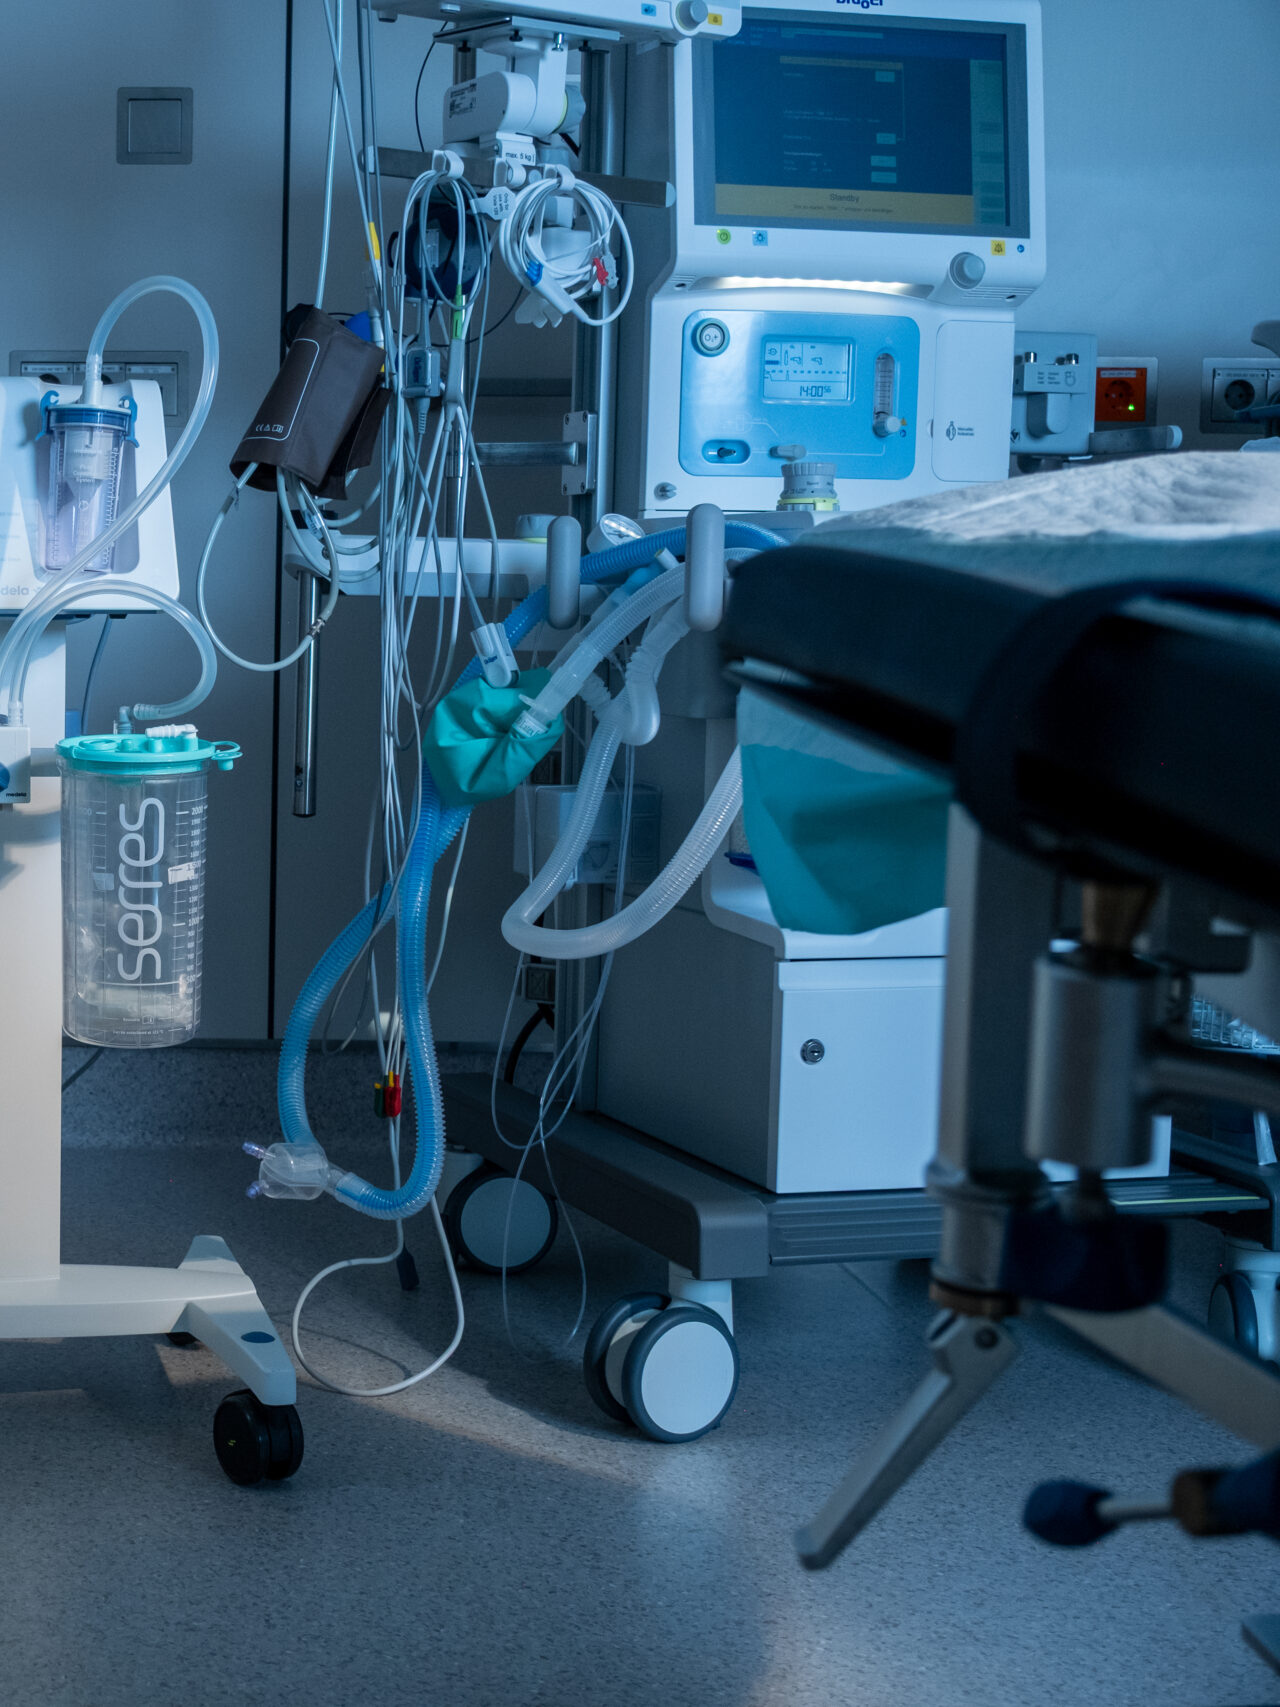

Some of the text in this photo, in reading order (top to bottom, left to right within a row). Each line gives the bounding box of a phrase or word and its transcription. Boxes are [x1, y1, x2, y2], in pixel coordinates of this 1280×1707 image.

[524, 153, 531, 161] kg
[799, 385, 823, 397] 14:00
[192, 805, 203, 815] 2000
[118, 798, 164, 980] serres
